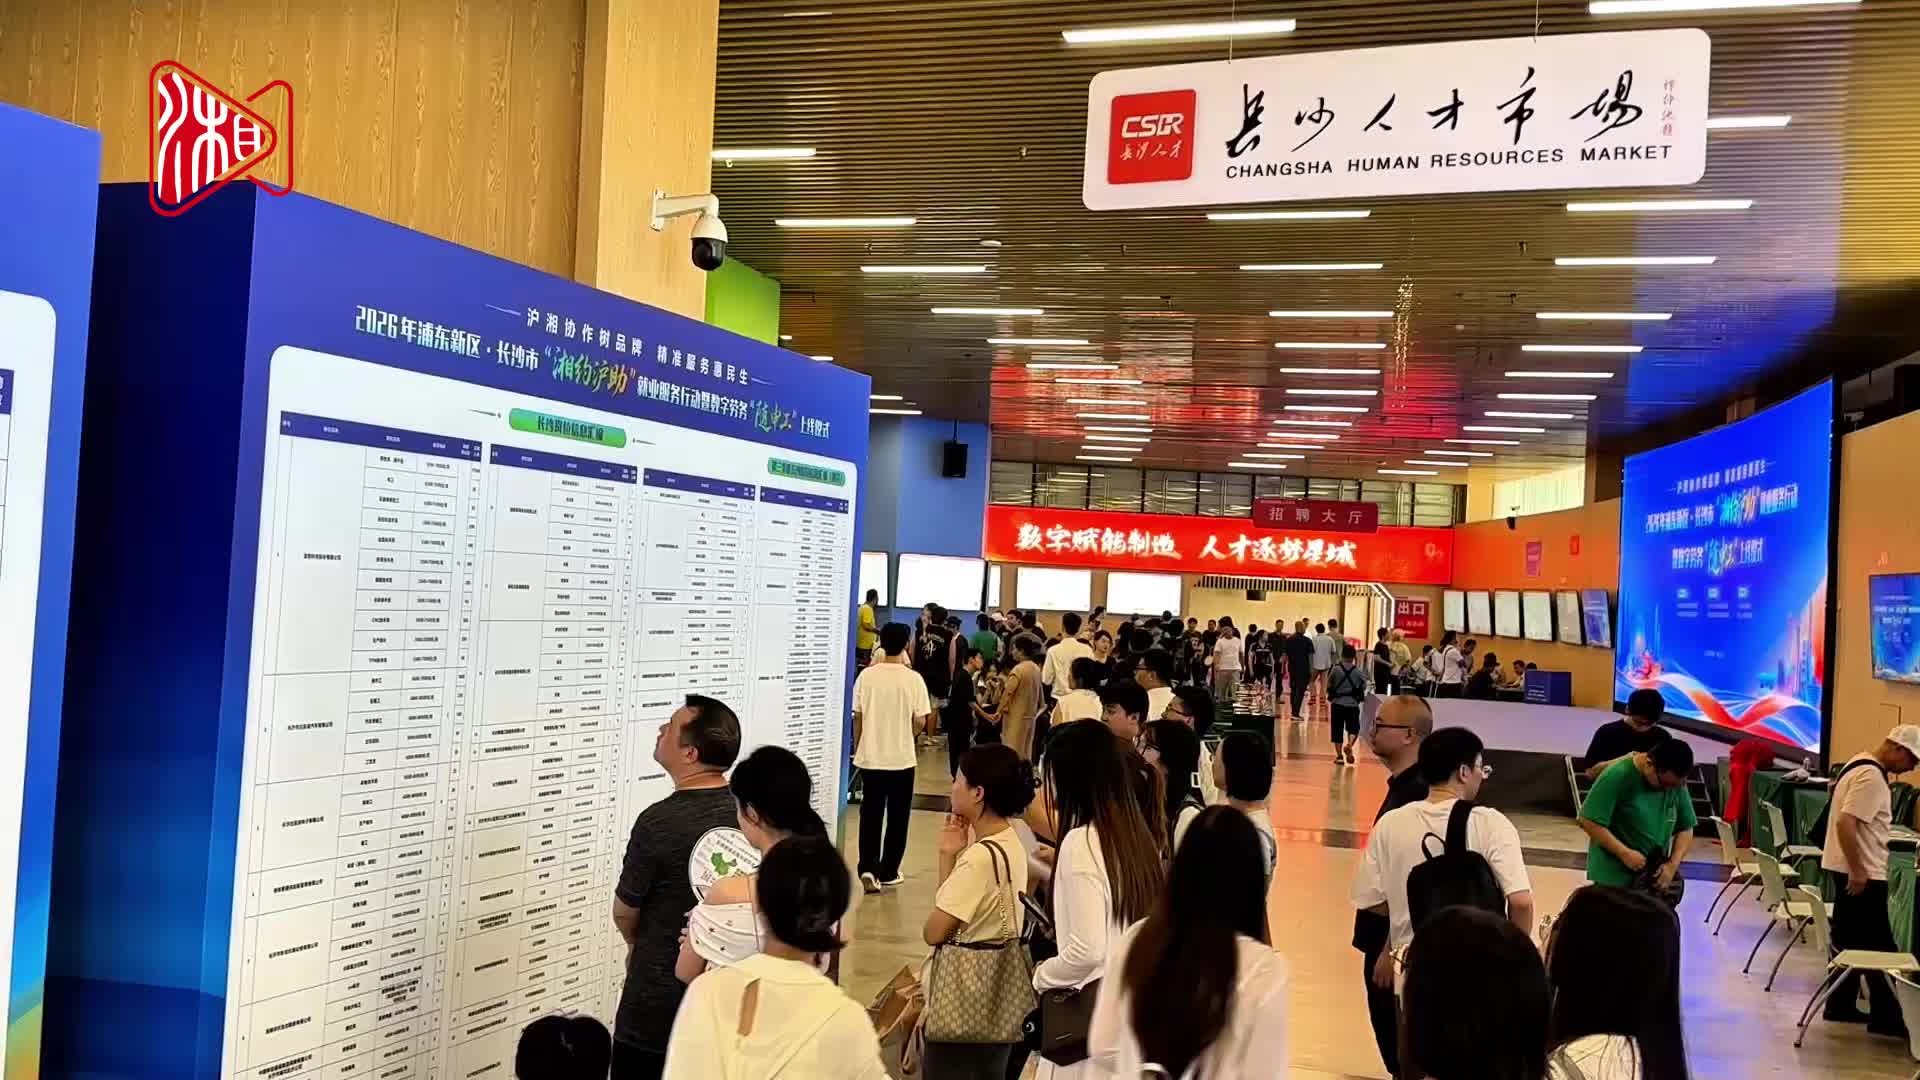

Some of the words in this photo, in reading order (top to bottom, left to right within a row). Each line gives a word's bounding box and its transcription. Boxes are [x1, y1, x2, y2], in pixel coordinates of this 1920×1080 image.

[1226, 160, 1333, 179] CHANGSHA
[1347, 155, 1420, 172] HUMAN
[1430, 148, 1564, 169] RESOURCES
[1580, 144, 1673, 162] MARKET
[527, 307, 643, 358] 沪湘协作树品牌
[656, 344, 749, 386] 精准服务惠民生
[1268, 506, 1363, 525] 招聘大厅
[1015, 522, 1183, 561] 数字赋能制造
[1198, 533, 1357, 569] 人才逐梦星城
[1397, 601, 1425, 616] 出口
